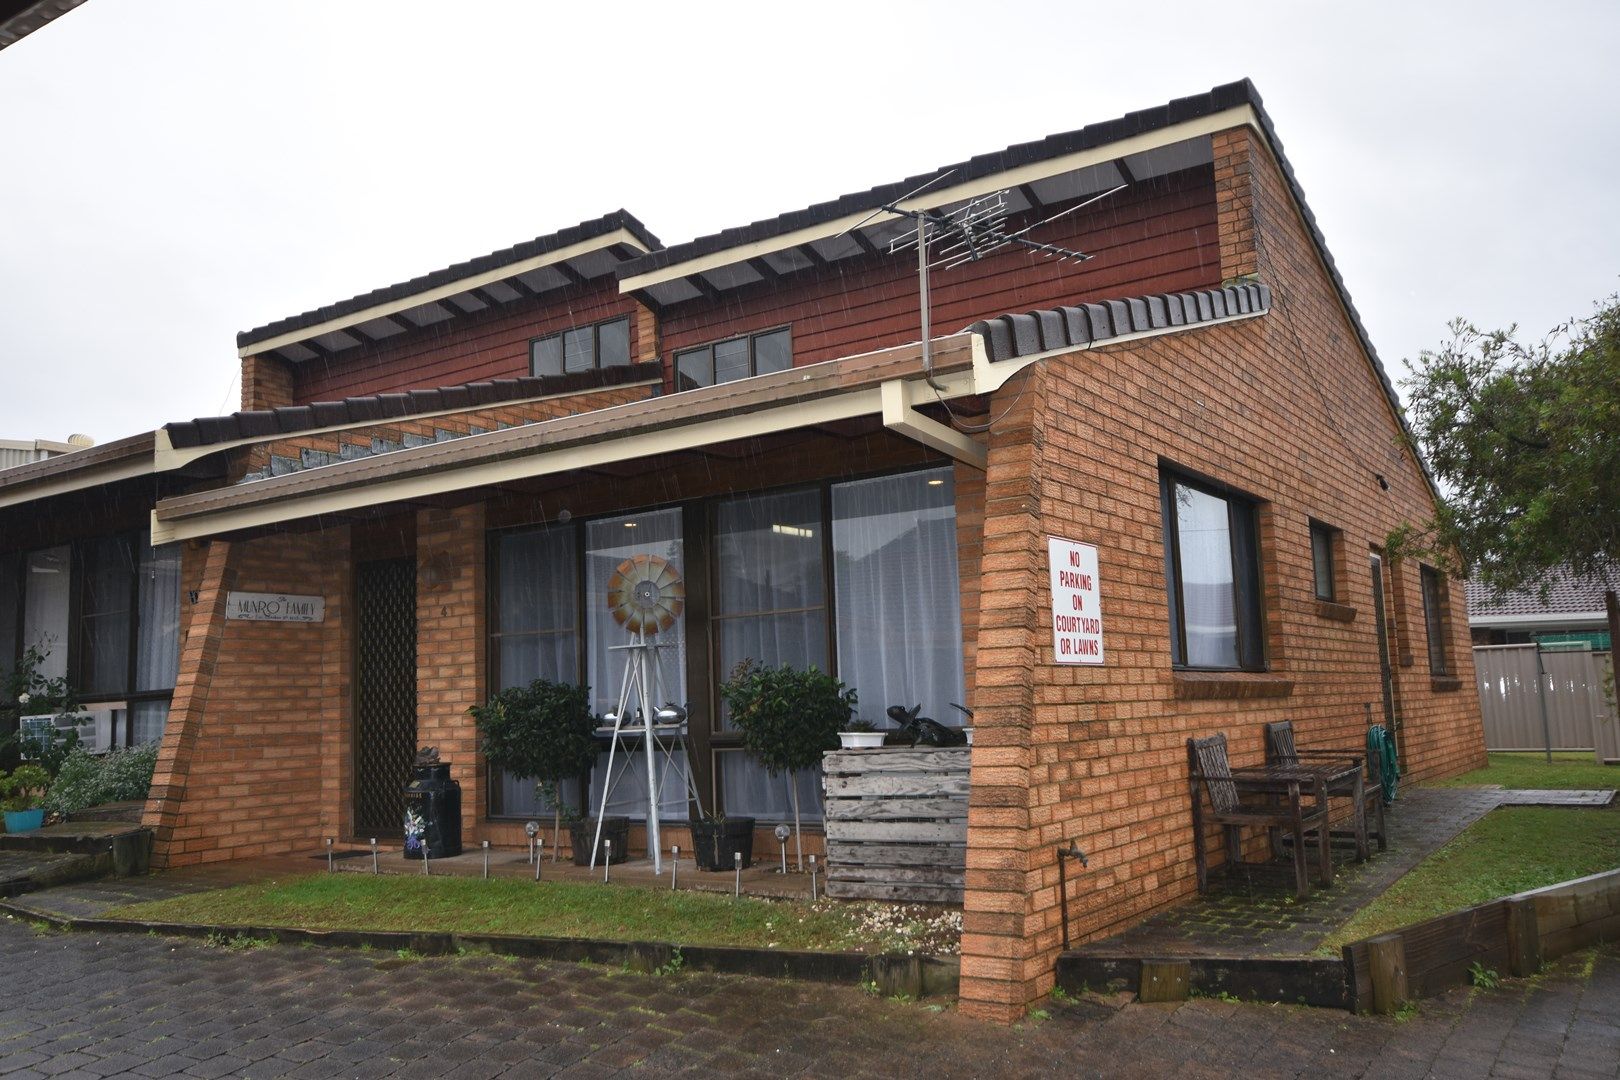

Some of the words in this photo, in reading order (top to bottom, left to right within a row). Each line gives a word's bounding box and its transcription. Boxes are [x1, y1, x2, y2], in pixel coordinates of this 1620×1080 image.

[1069, 550, 1080, 568] NO
[1060, 570, 1092, 591] PARKING
[238, 600, 280, 617] MUNRO
[286, 601, 315, 615] FAMILY
[441, 605, 448, 617] 4
[1072, 594, 1083, 611] ON
[1056, 614, 1100, 635] COURTYARD
[1060, 638, 1072, 655] OR
[1073, 638, 1099, 656] LAWNS
